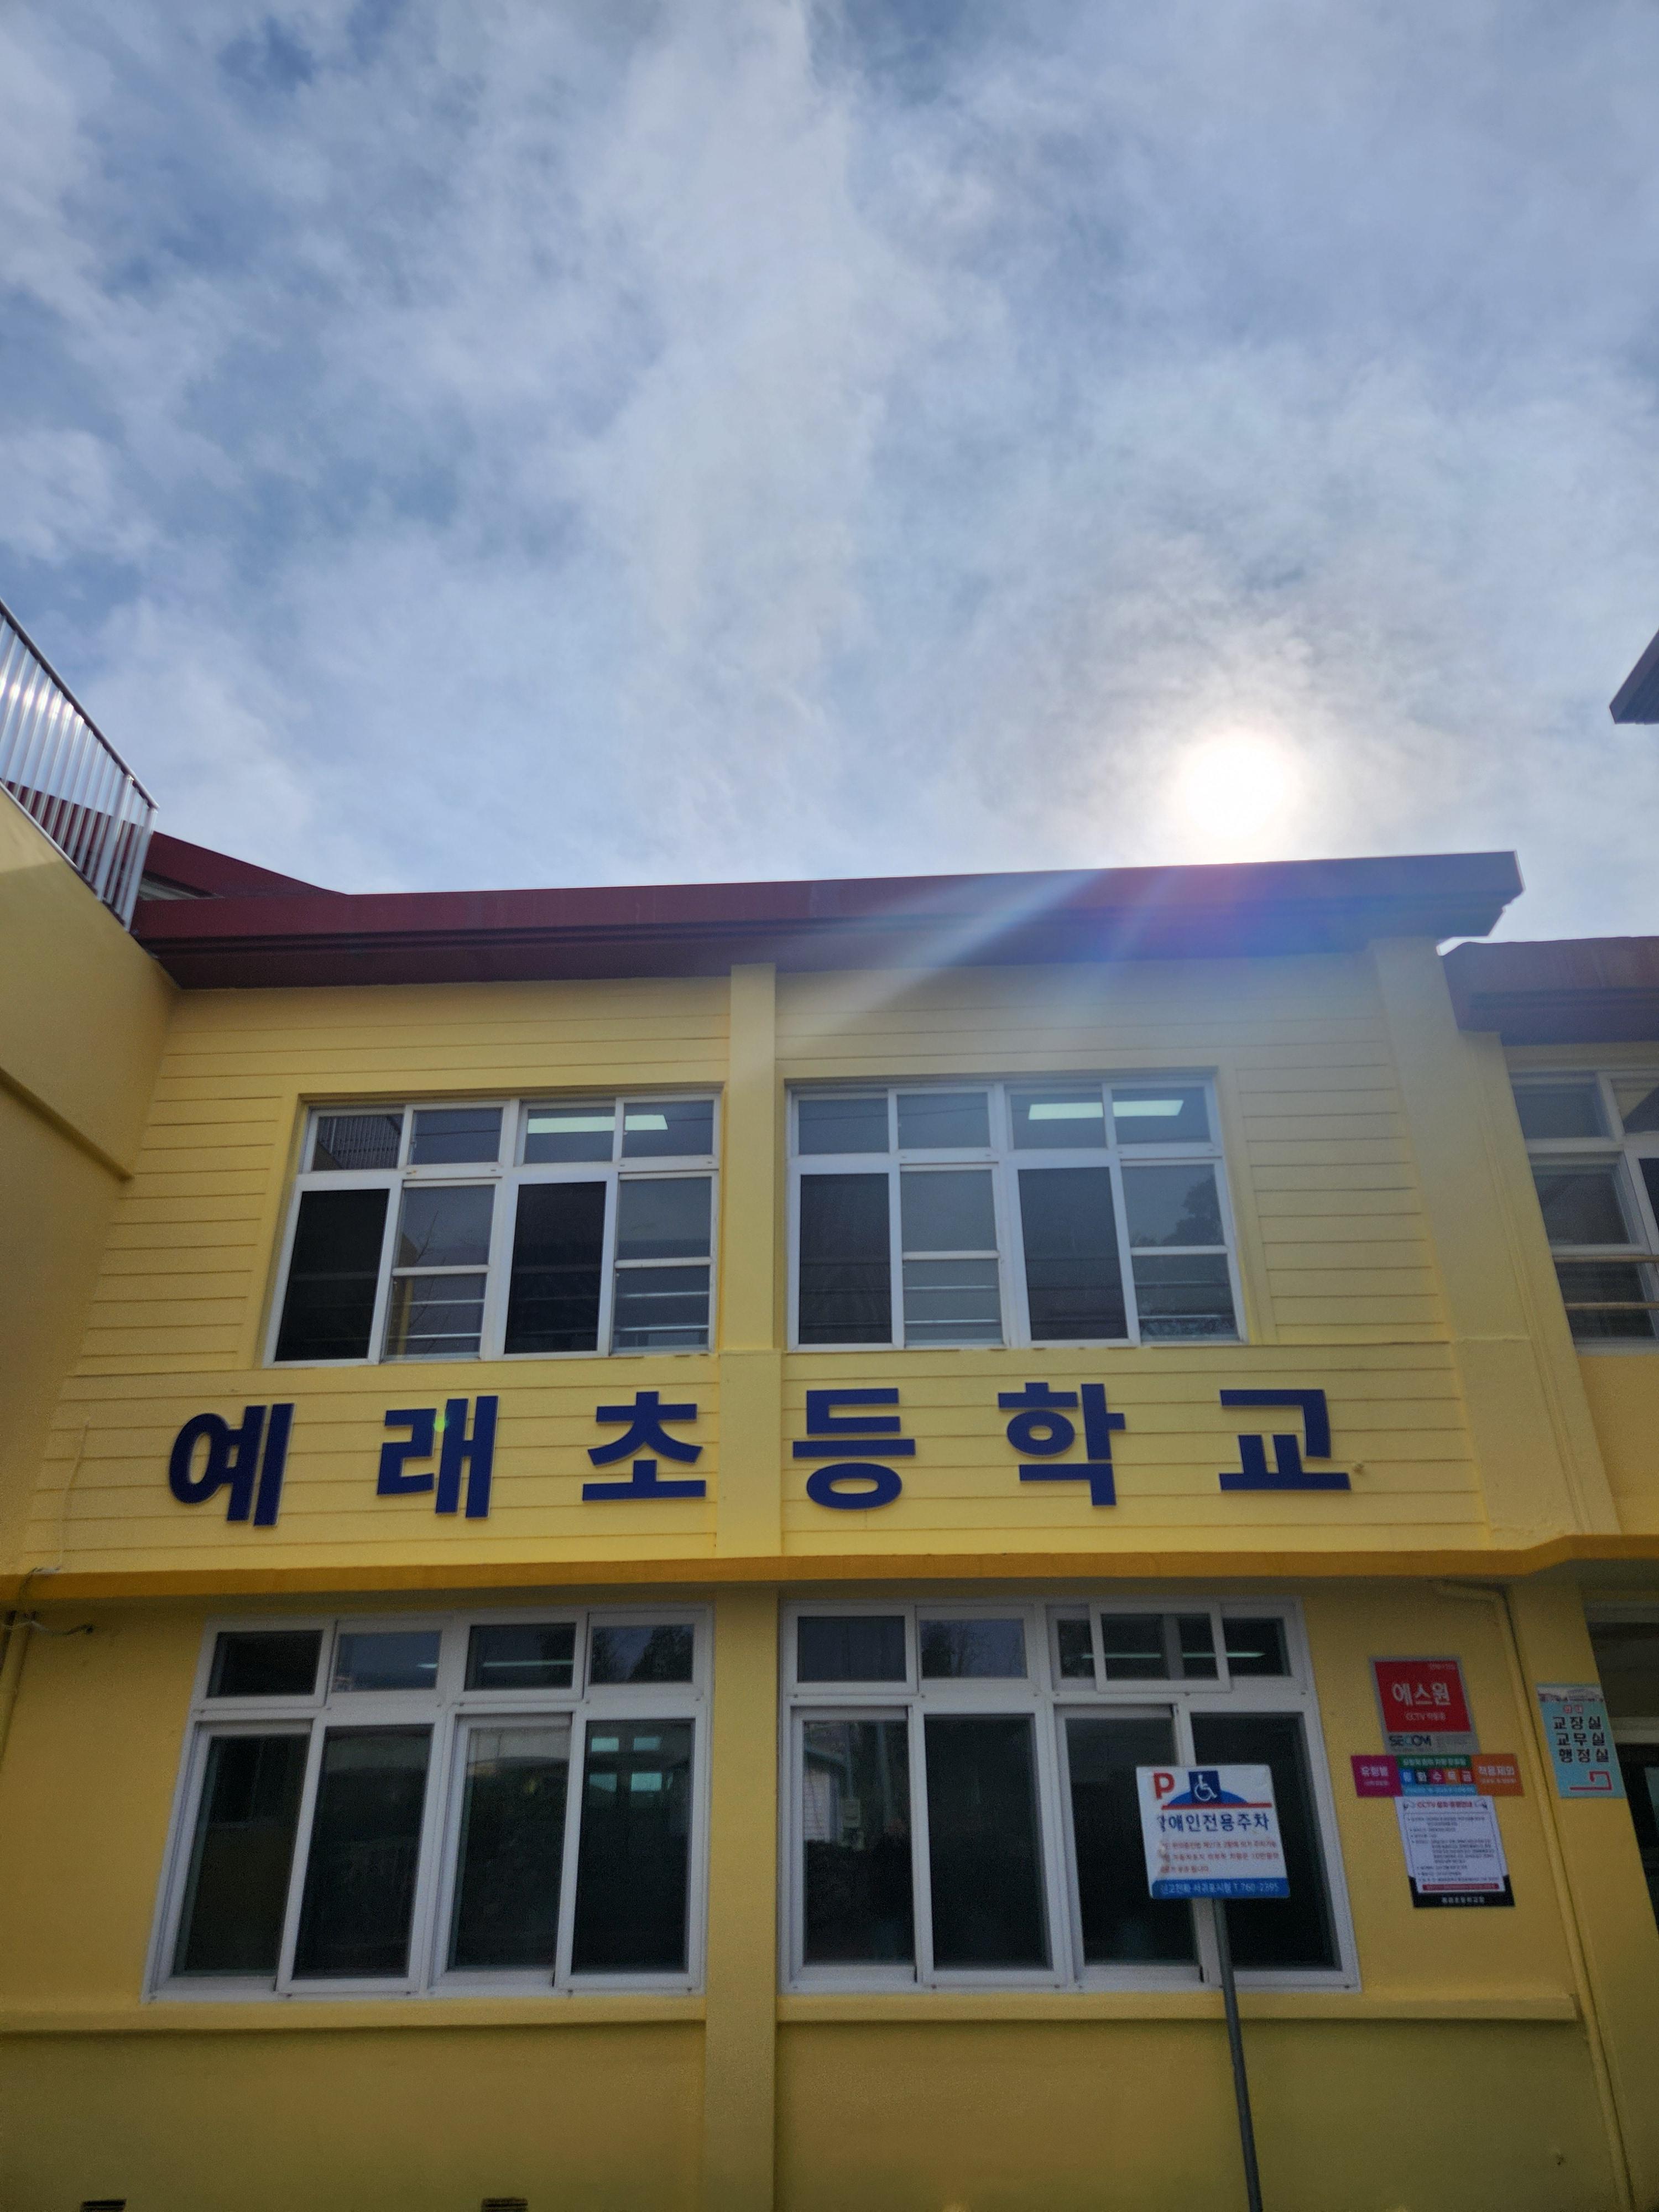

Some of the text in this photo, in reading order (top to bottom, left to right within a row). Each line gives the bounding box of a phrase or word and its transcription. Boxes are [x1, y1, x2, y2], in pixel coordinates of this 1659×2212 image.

[170, 1381, 1353, 1527] 예래초등학교
[1391, 1682, 1451, 1706] 에스원
[1552, 1716, 1602, 1730] 교장실
[1388, 1735, 1432, 1747] SECOM
[1556, 1732, 1605, 1746] 교무실
[1559, 1749, 1609, 1763] 행정실
[1154, 1772, 1175, 1800] P
